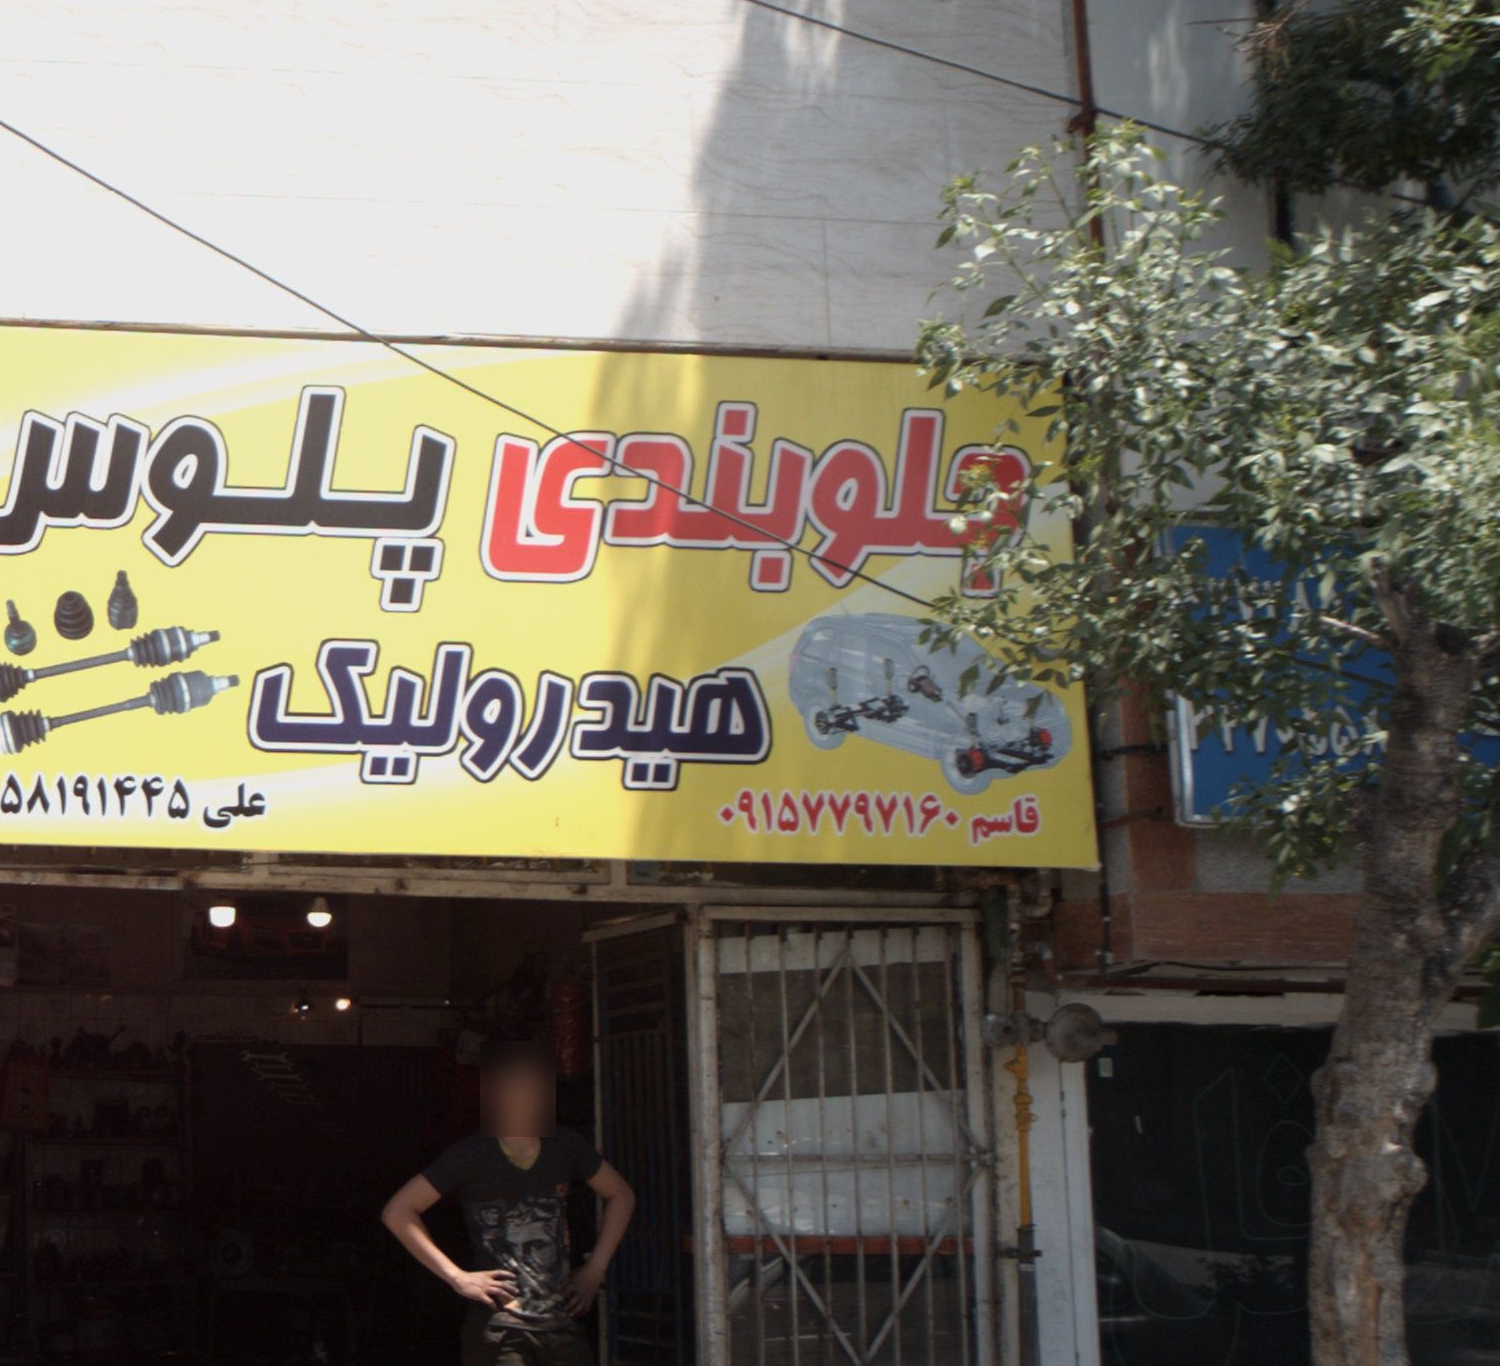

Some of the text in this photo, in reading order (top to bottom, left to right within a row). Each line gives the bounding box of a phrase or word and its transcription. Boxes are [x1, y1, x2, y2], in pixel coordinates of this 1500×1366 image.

[480, 401, 1031, 598] جلوبندی
[247, 638, 772, 790] هیدرولیک
[202, 781, 267, 828] علی
[719, 790, 1041, 844] قاسم ۰۹۱۵۷۷۹۷۱۶۰
